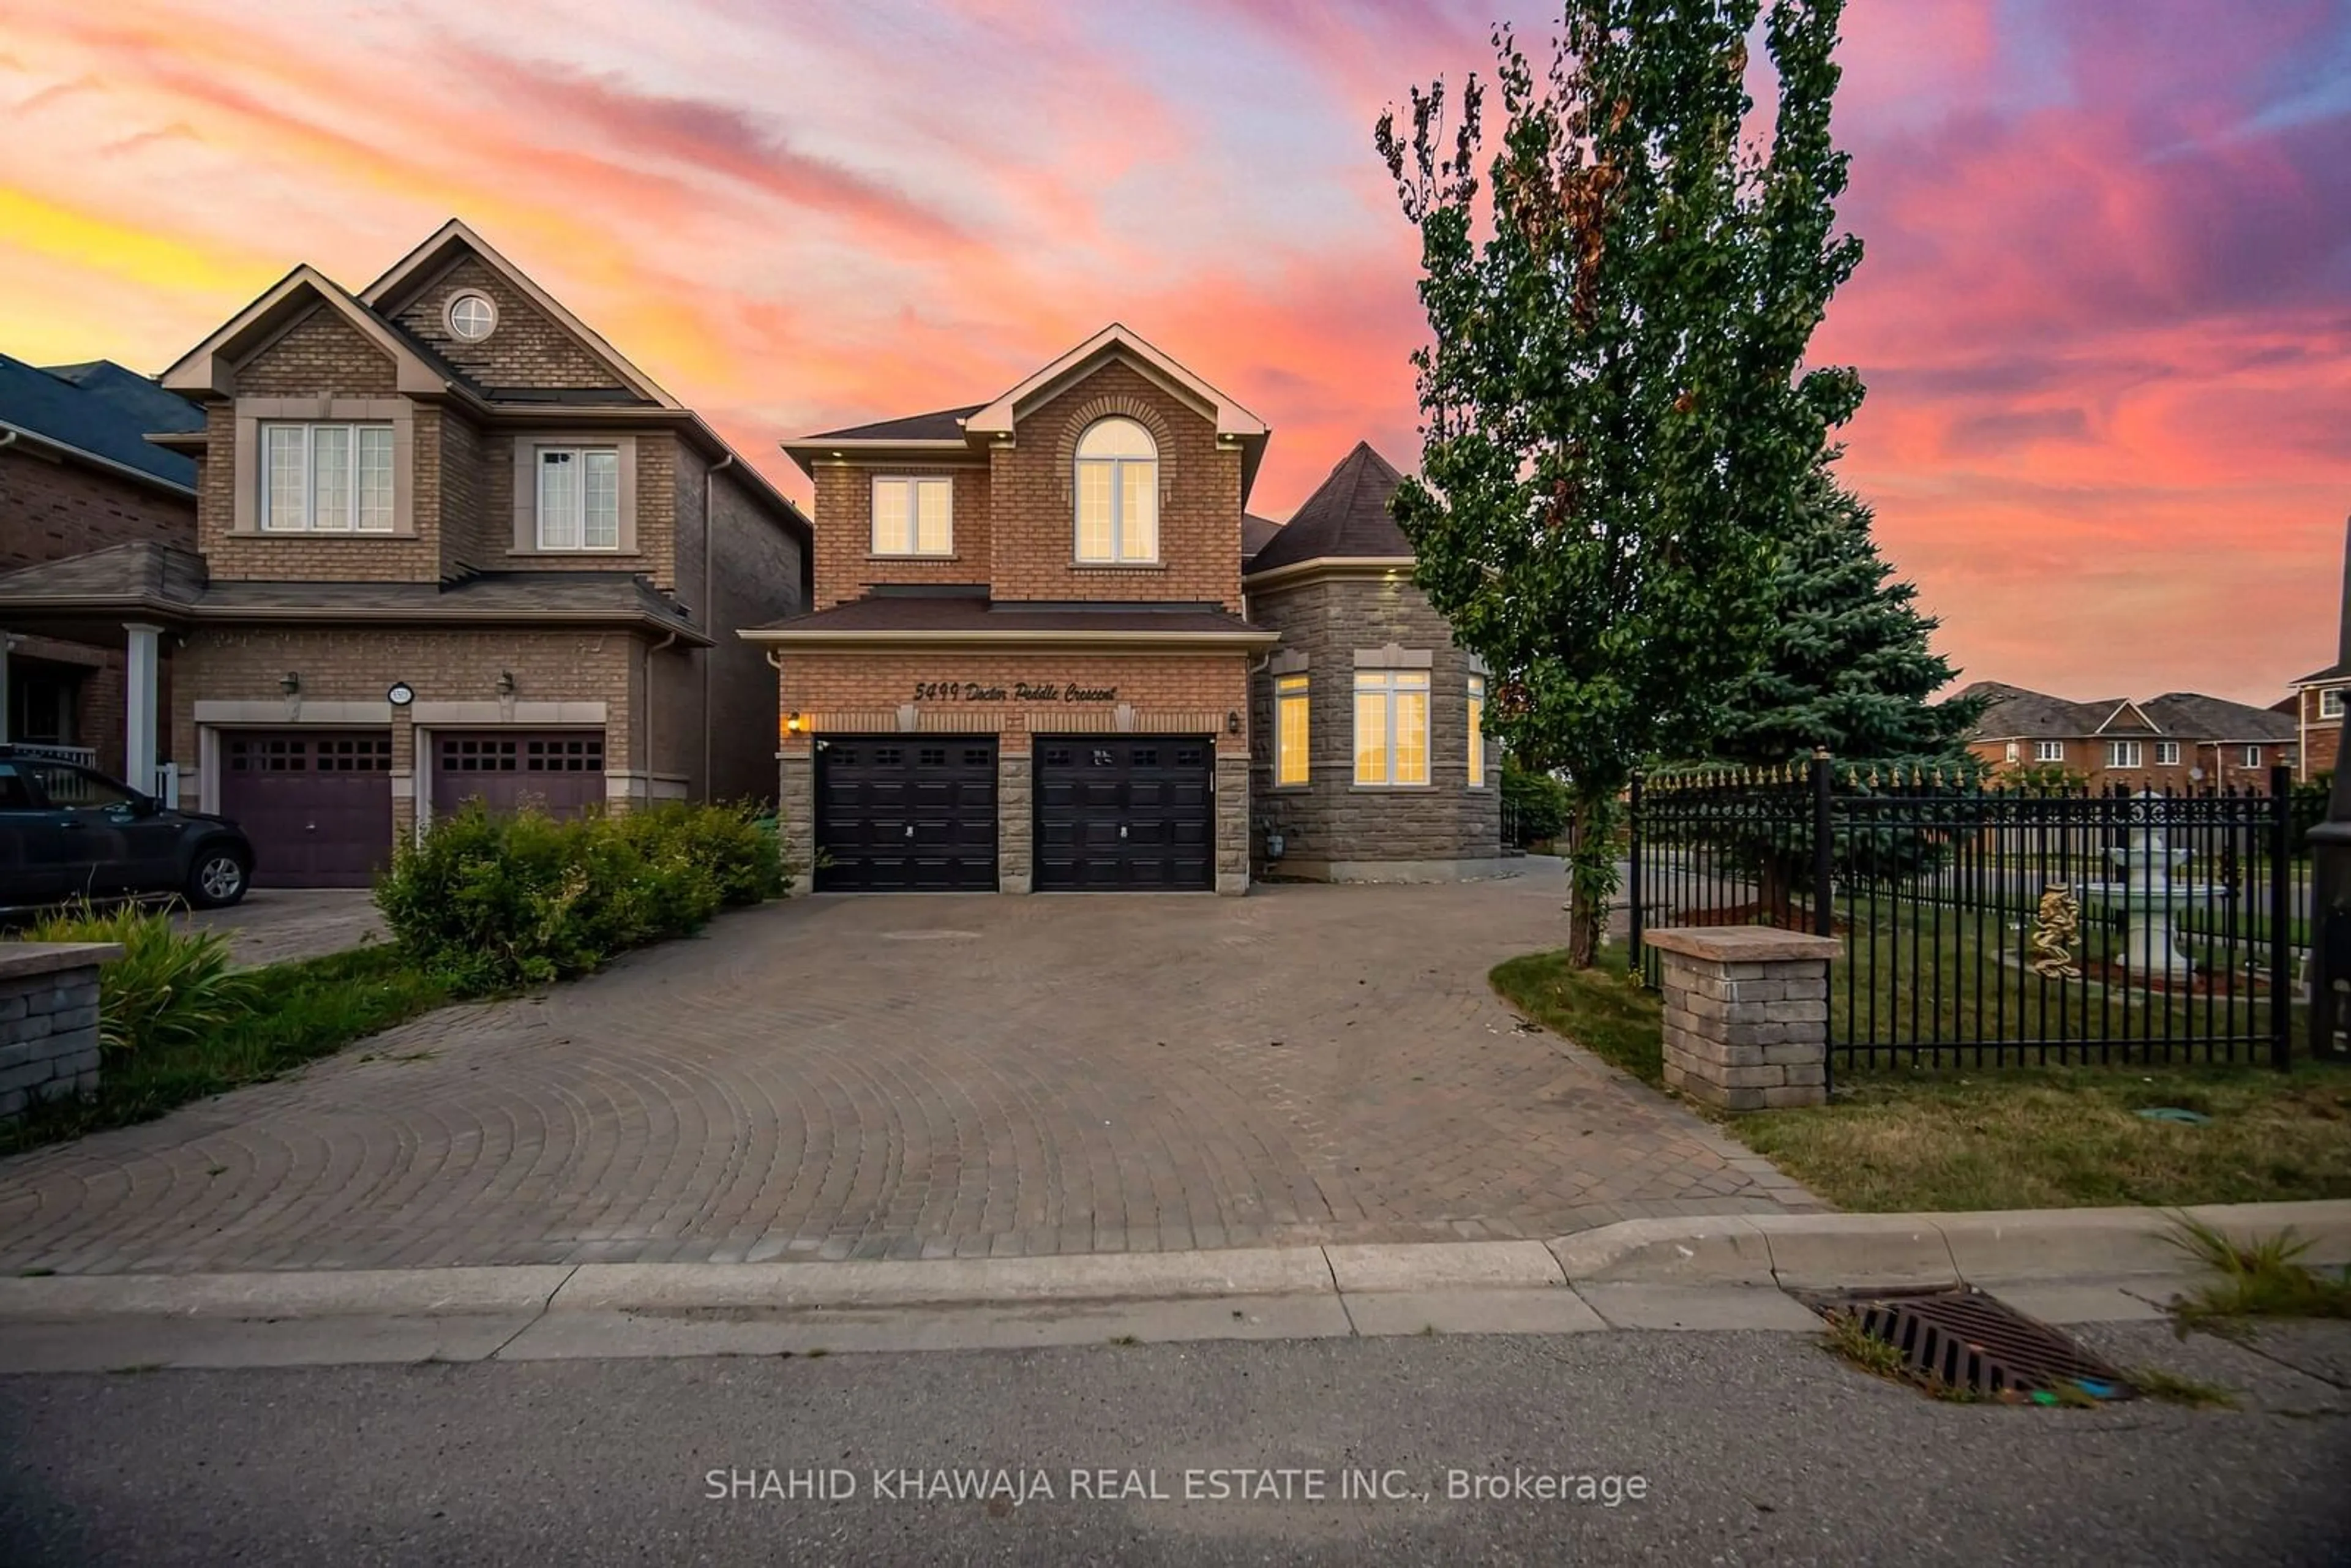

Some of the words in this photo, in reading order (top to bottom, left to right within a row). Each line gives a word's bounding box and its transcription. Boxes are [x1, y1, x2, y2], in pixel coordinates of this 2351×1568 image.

[913, 682, 959, 701] 5499
[964, 683, 1007, 701] Doctor
[1065, 683, 1117, 702] Crescent
